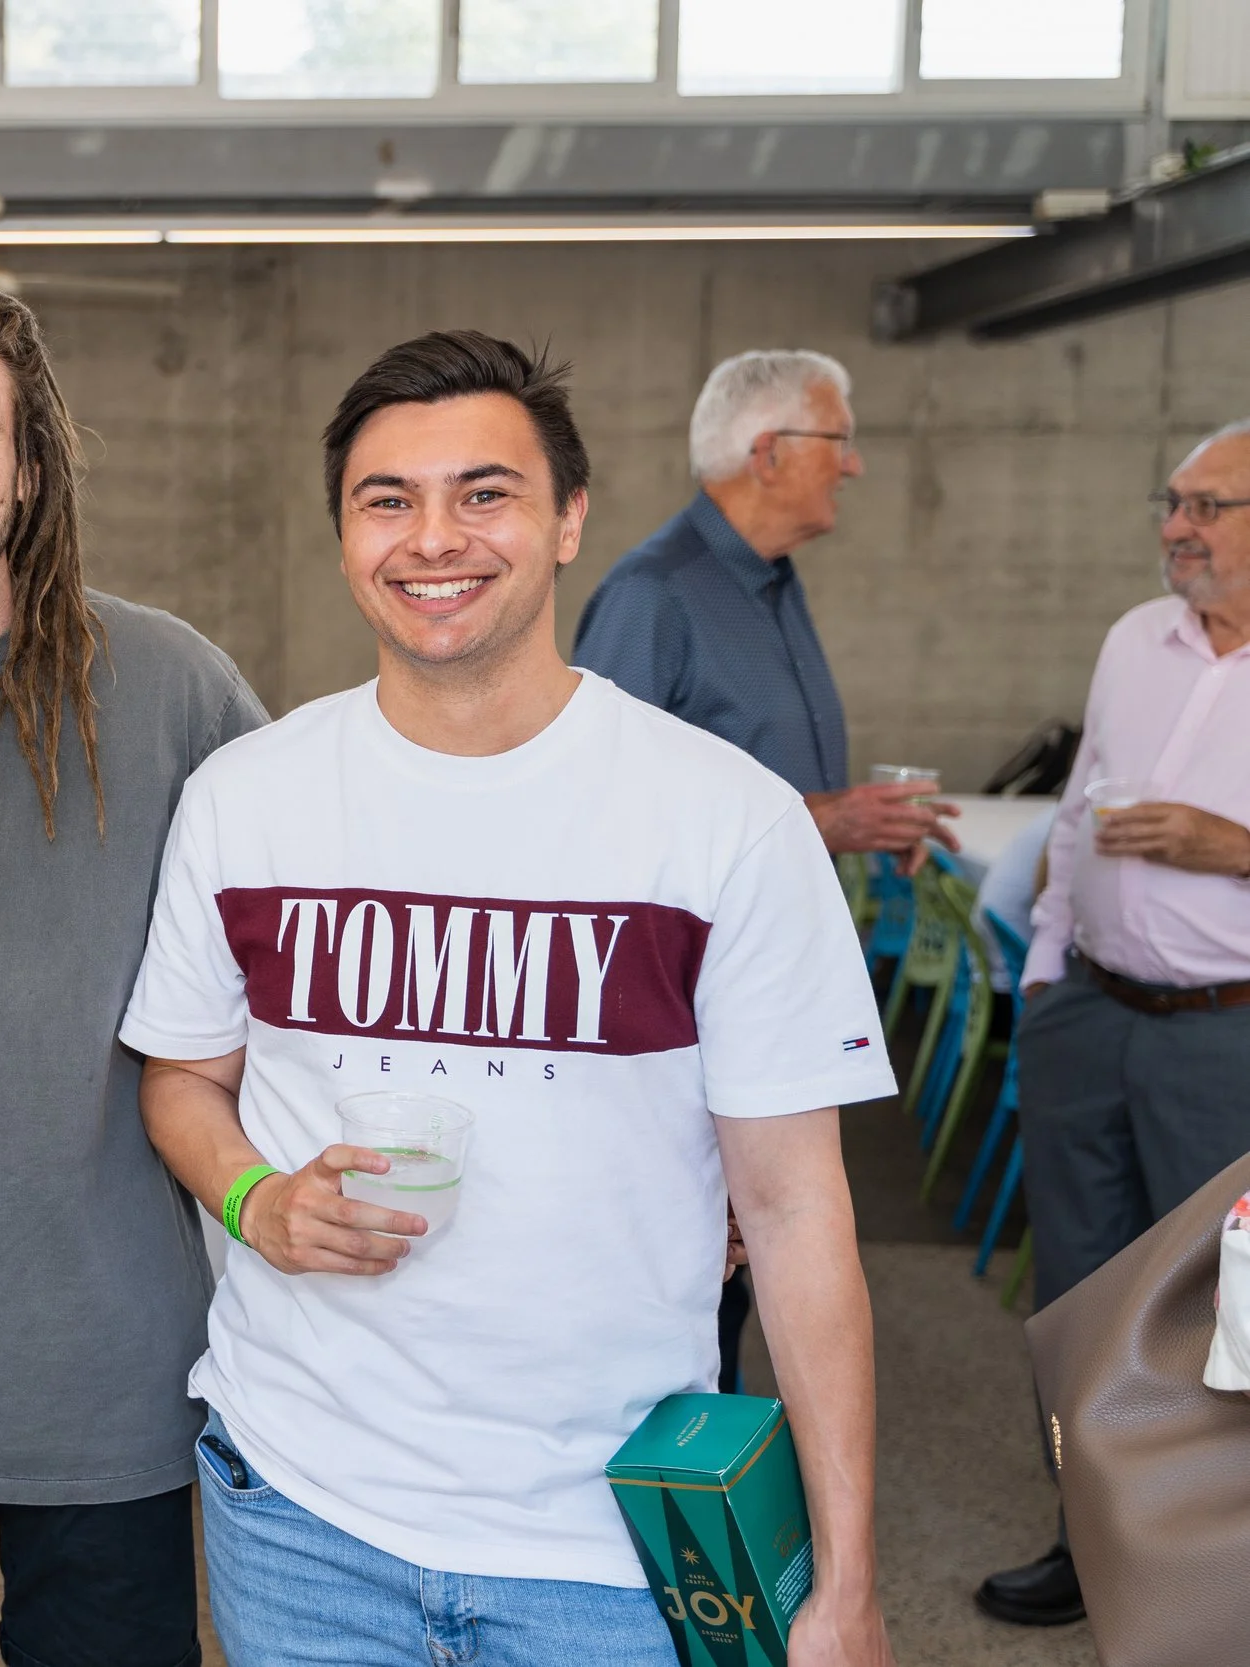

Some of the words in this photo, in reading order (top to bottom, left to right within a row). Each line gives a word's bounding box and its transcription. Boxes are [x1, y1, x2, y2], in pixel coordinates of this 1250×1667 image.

[277, 898, 630, 1044] TOMMY
[333, 1054, 556, 1080] JEANS
[231, 1194, 240, 1213] Entry
[685, 1578, 715, 1587] CRAFTED
[663, 1586, 757, 1630] JOY
[701, 1629, 739, 1639] CHRISTMAS
